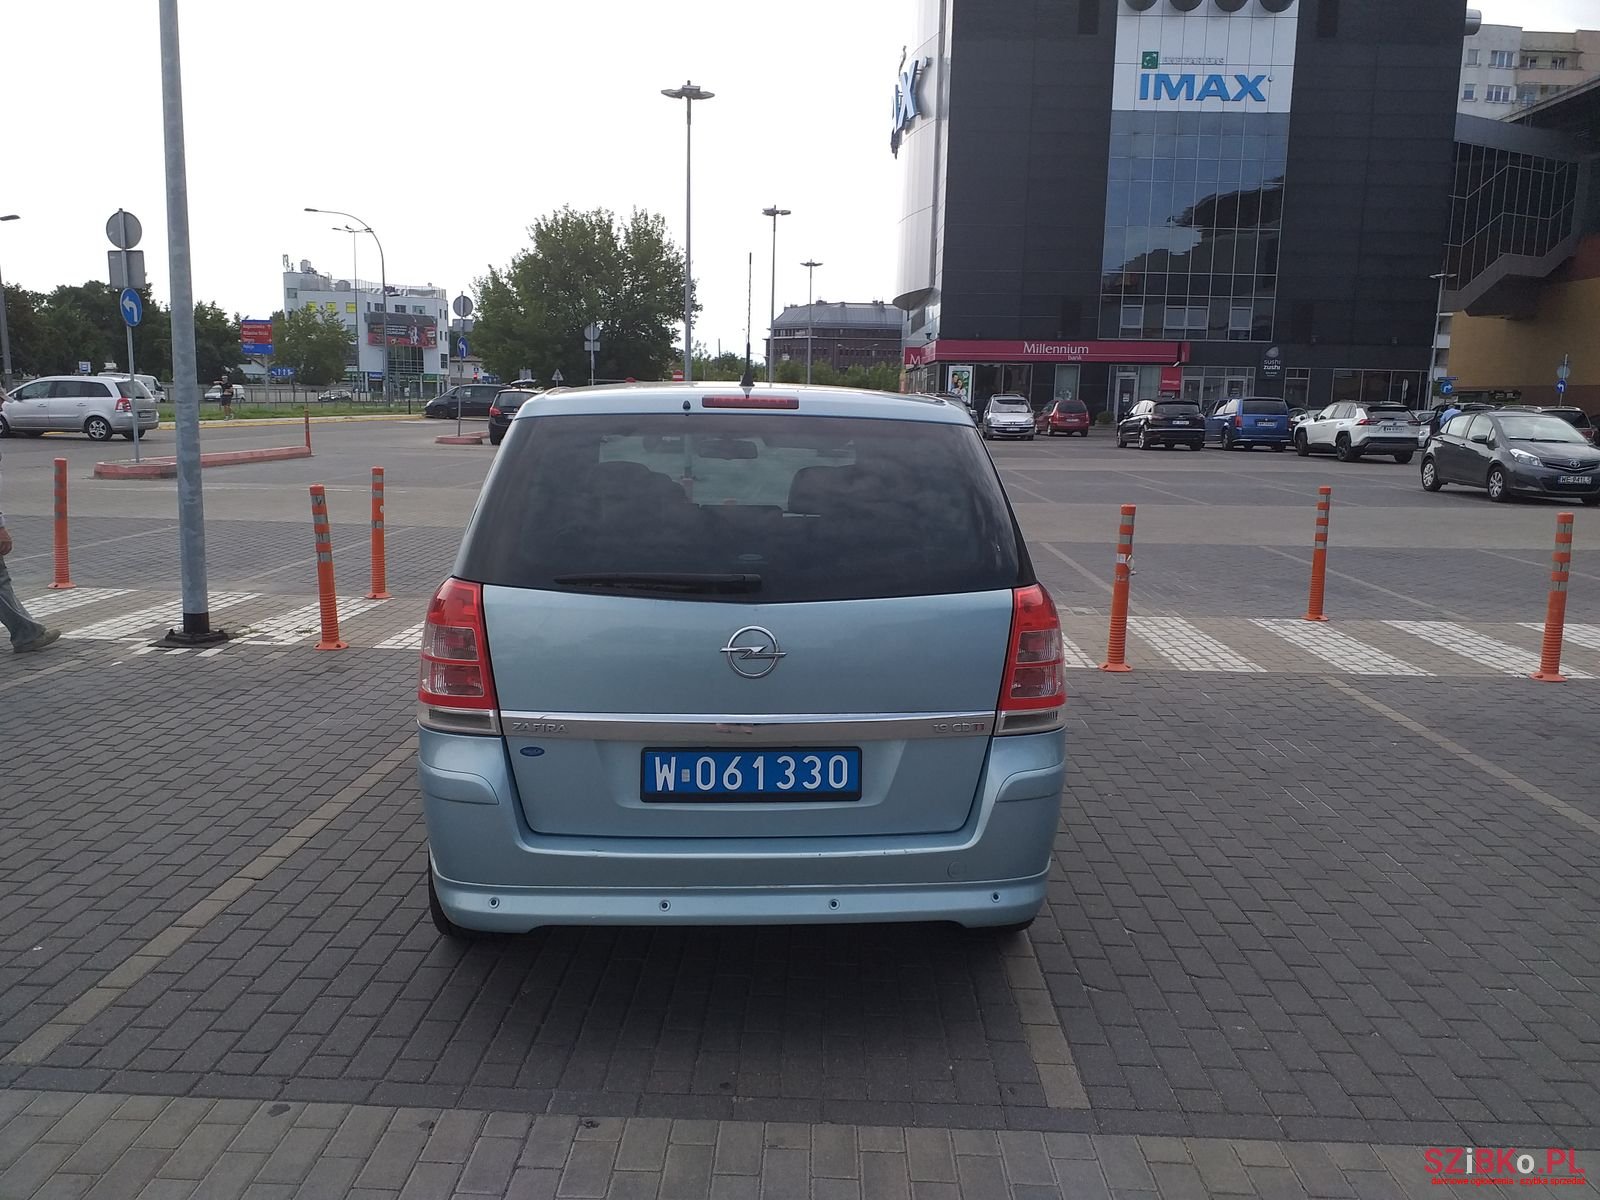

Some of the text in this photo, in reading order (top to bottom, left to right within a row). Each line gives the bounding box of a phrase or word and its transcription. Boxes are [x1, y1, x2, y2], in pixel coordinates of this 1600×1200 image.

[1139, 73, 1267, 102] IMAX
[1023, 341, 1089, 354] Millennium
[511, 722, 568, 733] ZAFIRA
[654, 755, 849, 792] W 061330
